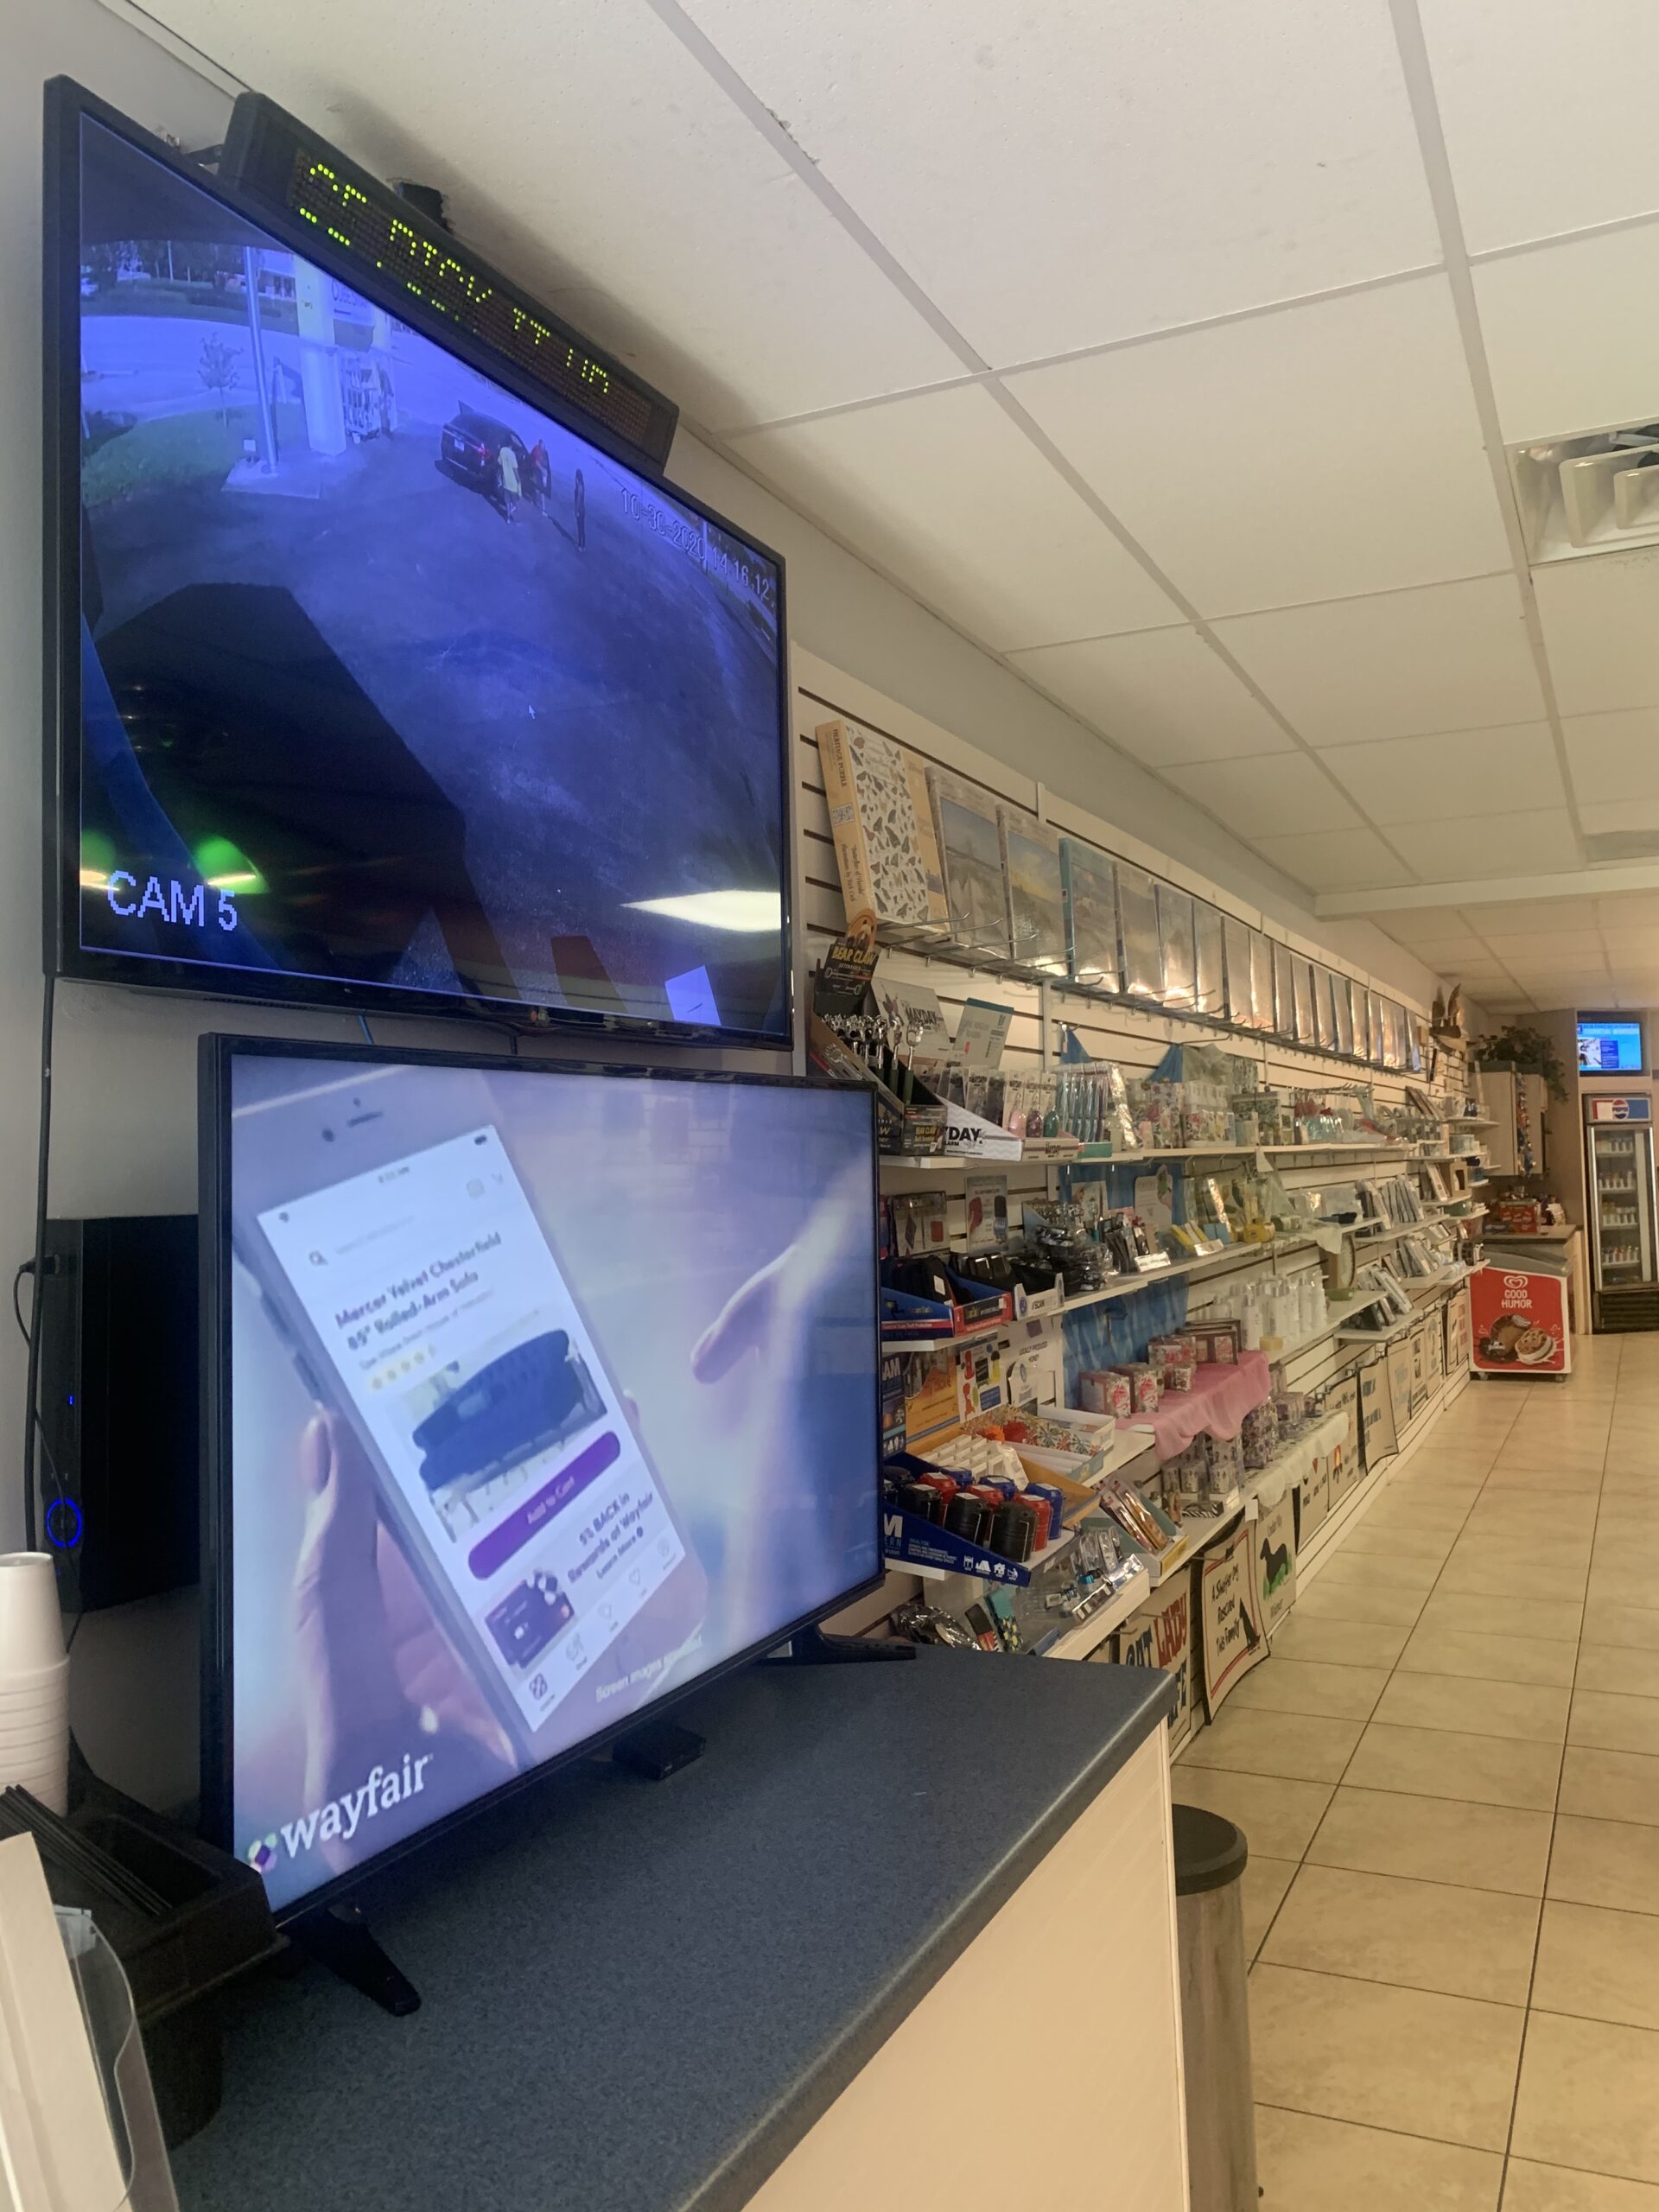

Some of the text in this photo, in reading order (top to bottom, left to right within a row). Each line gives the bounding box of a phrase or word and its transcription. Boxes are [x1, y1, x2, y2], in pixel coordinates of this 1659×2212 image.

[621, 487, 706, 561] 10-30-2020
[107, 870, 238, 931] CAM 5
[832, 945, 877, 965] BEAR CLAW
[907, 1007, 938, 1025] MAYDAY
[1501, 1299, 1533, 1309] HUMOR
[1504, 1289, 1528, 1299] GOOD
[593, 1500, 620, 1532] BACK
[620, 1492, 653, 1529] Wayfair
[1153, 1589, 1188, 1669] LADY
[281, 1754, 429, 1859] wayfair
